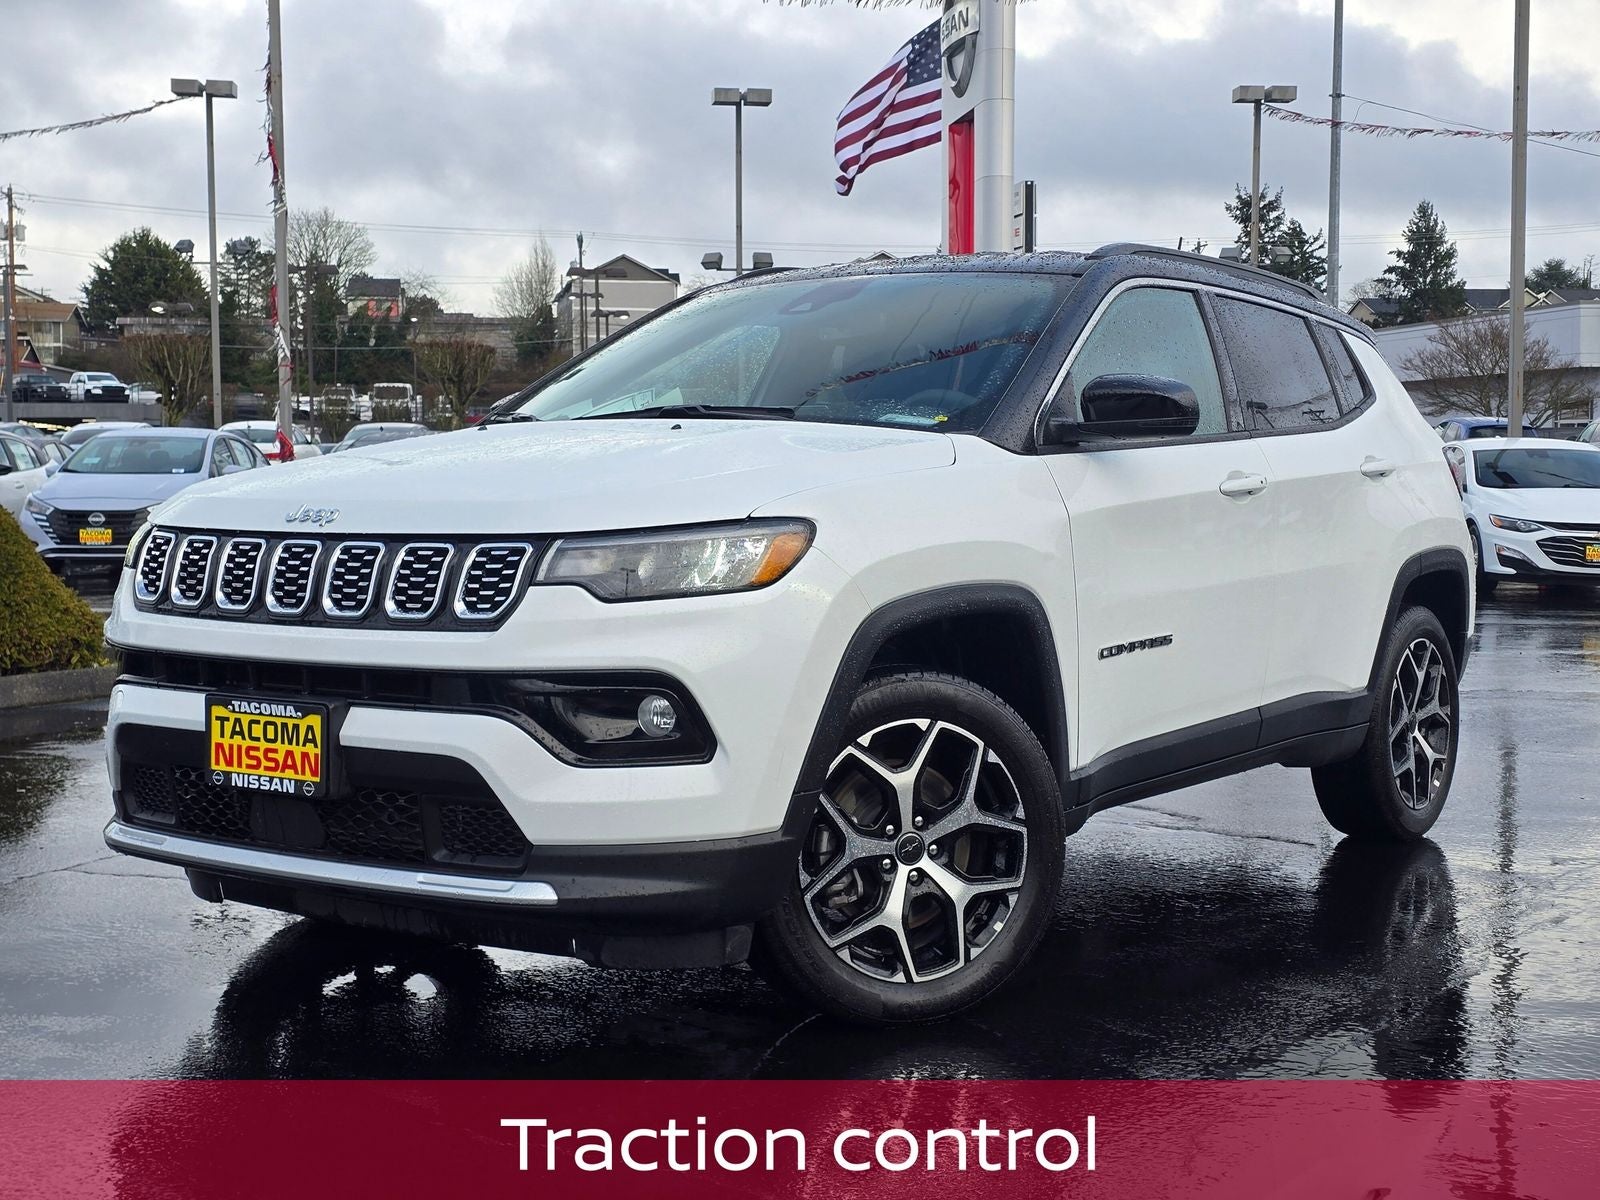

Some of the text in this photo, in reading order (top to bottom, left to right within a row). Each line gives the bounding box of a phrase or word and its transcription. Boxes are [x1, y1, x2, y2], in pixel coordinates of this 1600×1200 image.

[285, 503, 340, 527] Jeep
[1098, 634, 1173, 660] COMPASS
[231, 700, 297, 718] TACOMA
[215, 715, 319, 749] TACOMA
[214, 741, 320, 778] NISSAN
[231, 772, 295, 794] NISSAN
